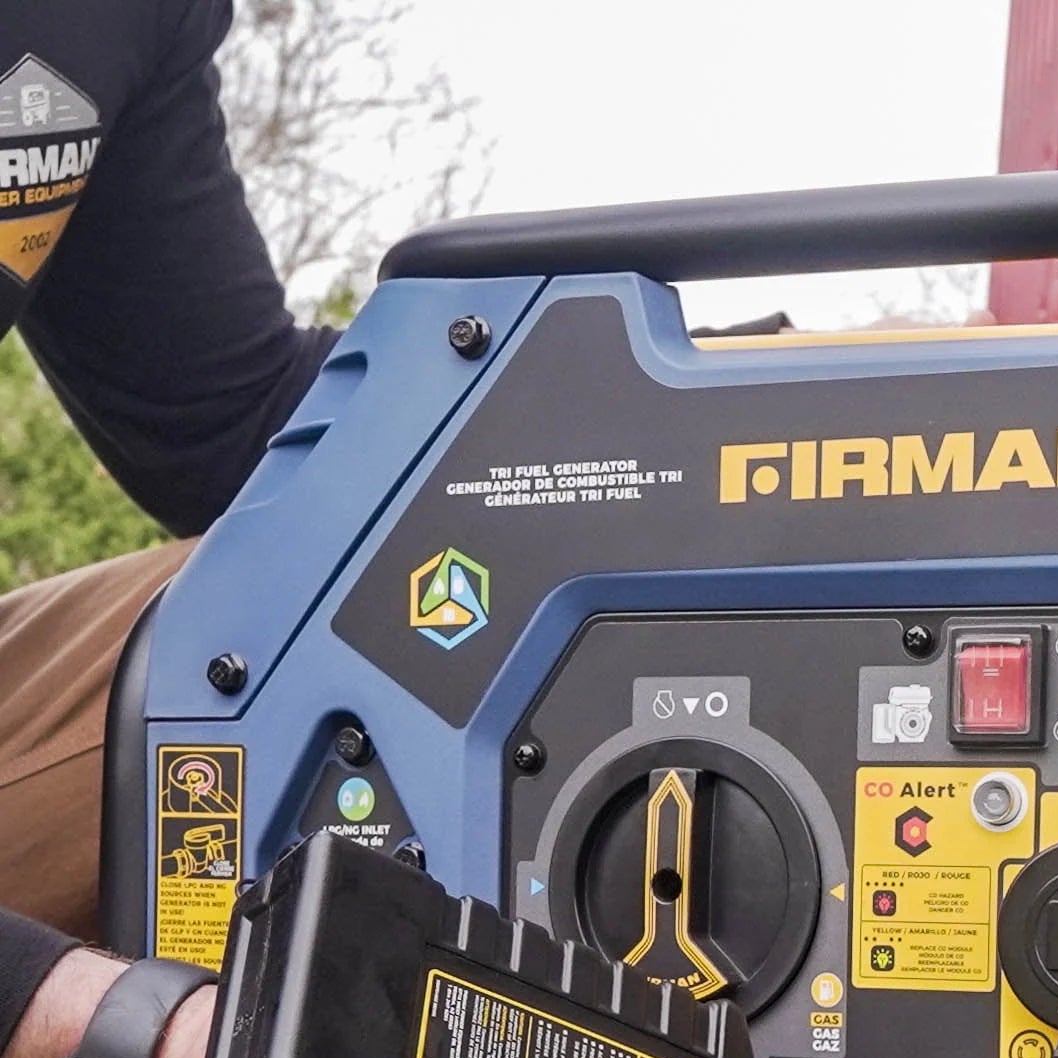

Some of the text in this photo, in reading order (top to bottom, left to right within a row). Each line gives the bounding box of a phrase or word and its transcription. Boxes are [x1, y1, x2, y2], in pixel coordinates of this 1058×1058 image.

[489, 460, 638, 480] TRI FUEL GENERATOR
[447, 470, 682, 495] GENERADOR DE COMBUSTIBLE TRI
[484, 487, 641, 507] GÉNÉRATEUR TRI FUEL
[864, 782, 894, 798] CO
[361, 825, 391, 835] INLET
[814, 1014, 839, 1025] GAS
[812, 1028, 840, 1039] GAS
[812, 1040, 840, 1052] GAZ
